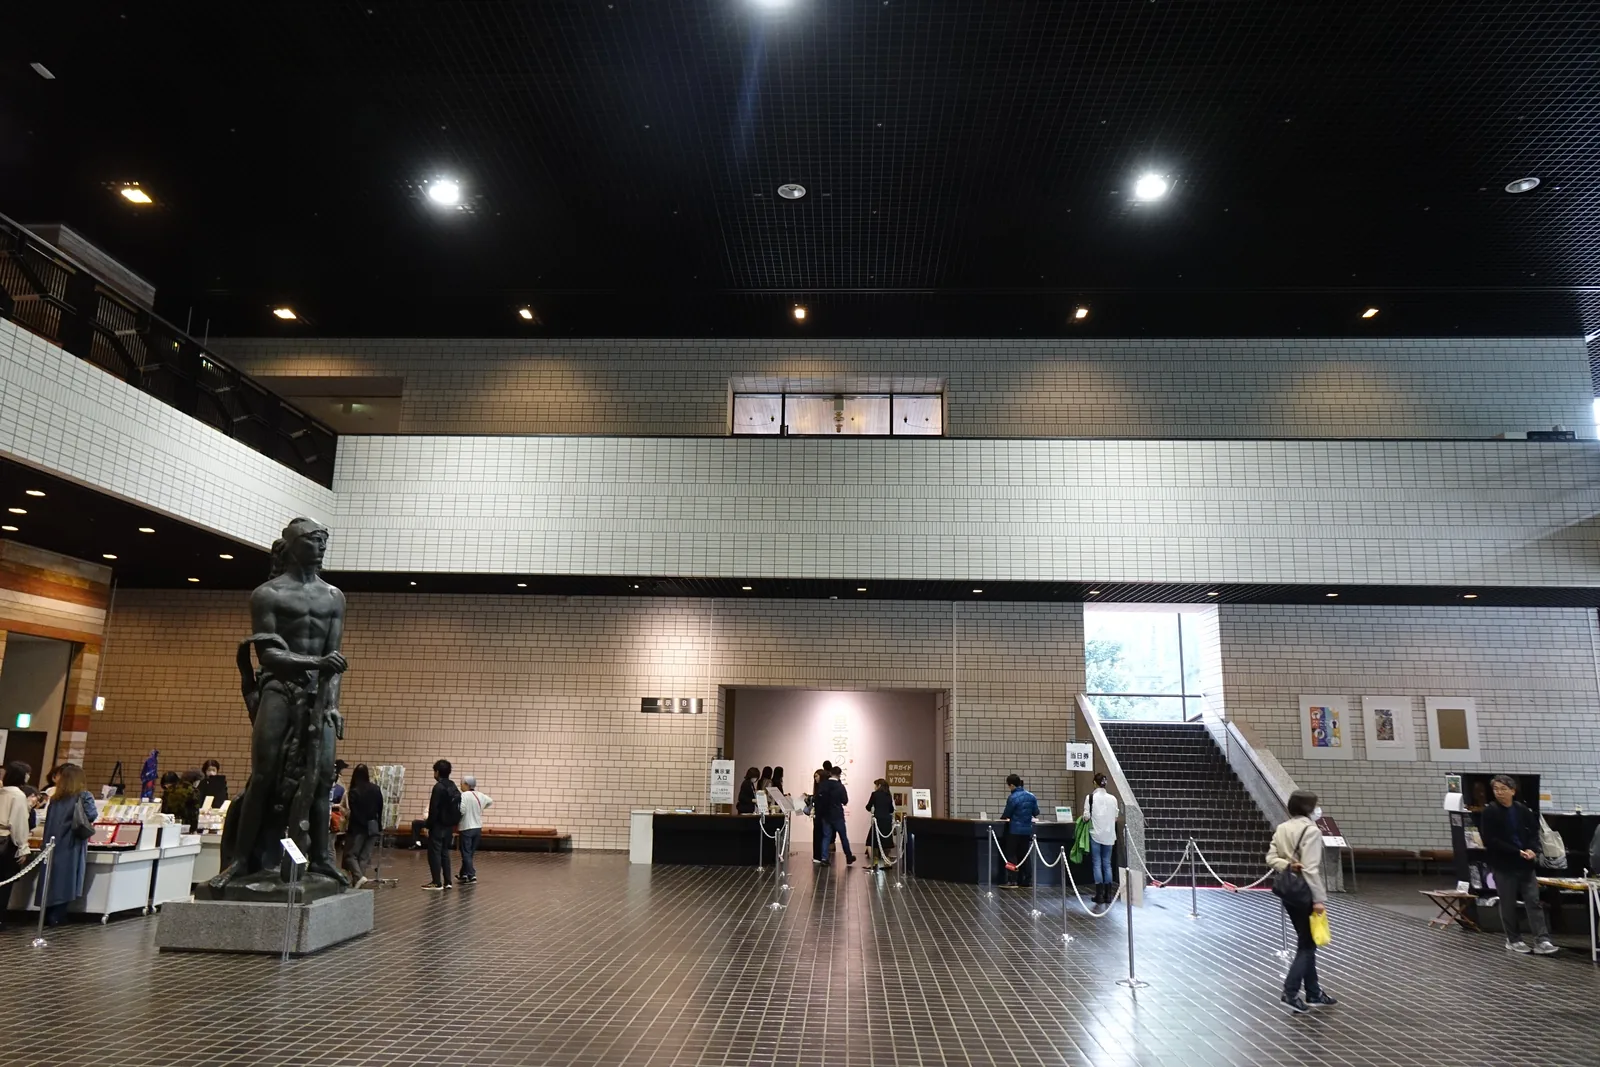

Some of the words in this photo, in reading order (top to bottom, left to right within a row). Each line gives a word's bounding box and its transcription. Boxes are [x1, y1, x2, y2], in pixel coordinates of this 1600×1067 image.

[1070, 752, 1089, 760] 当日券
[1073, 760, 1086, 768] 売場
